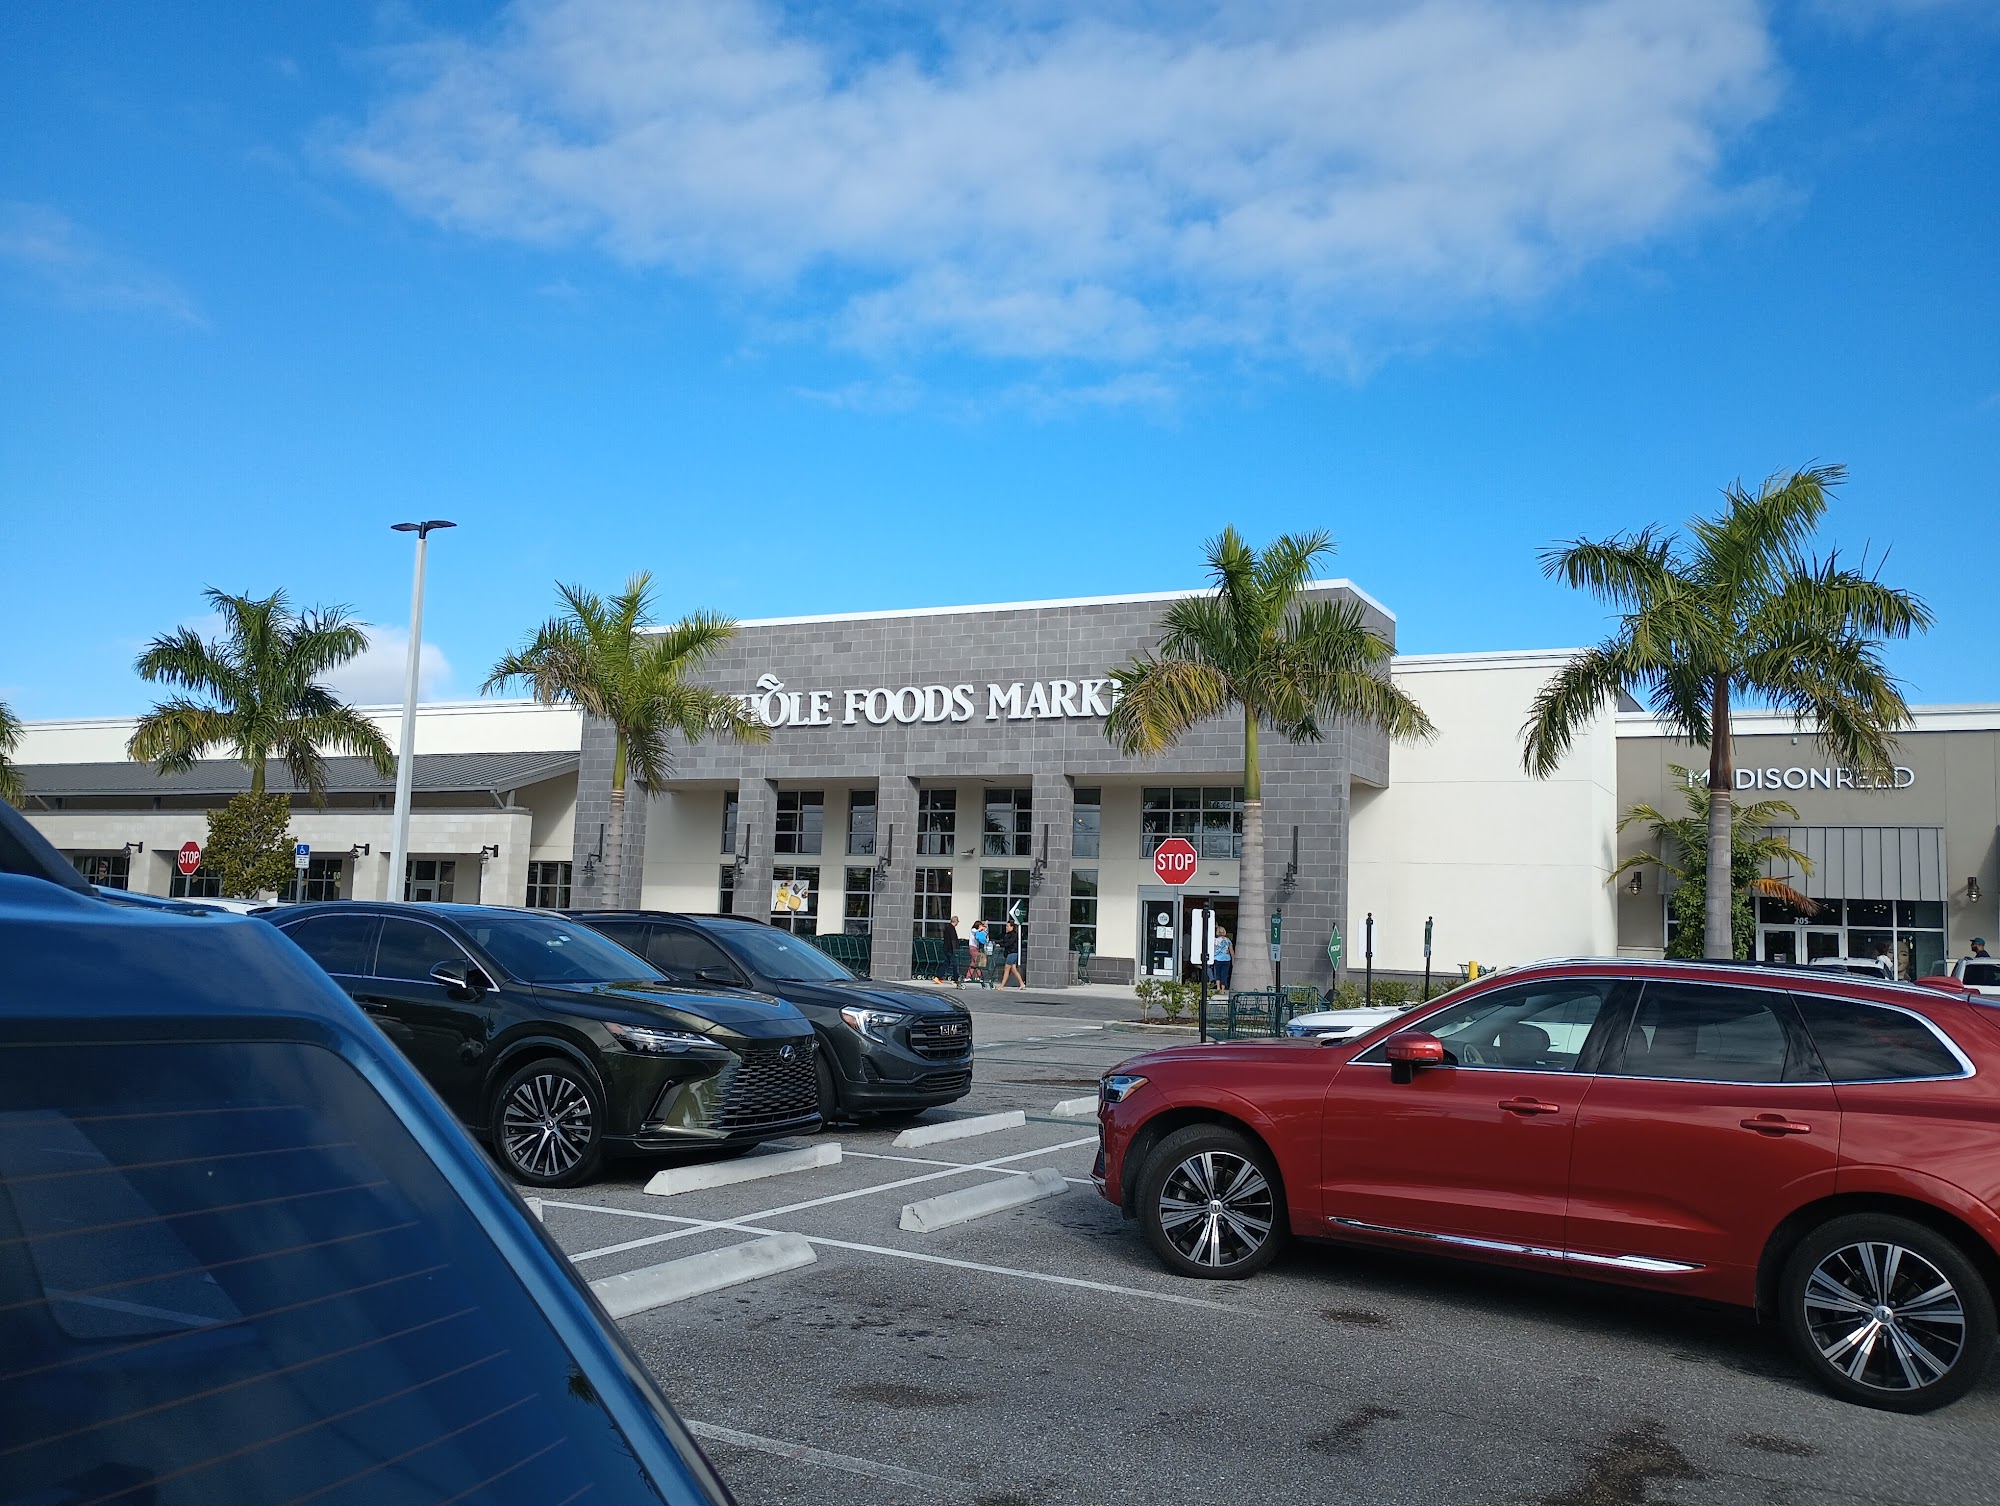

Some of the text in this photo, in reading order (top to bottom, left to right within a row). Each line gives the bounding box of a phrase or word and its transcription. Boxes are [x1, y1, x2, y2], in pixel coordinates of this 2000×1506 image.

[842, 684, 975, 725] FOODS
[985, 678, 1125, 719] MARK
[1687, 767, 1831, 790] MDISON
[180, 851, 200, 864] STOP
[1157, 853, 1195, 871] STOP
[1794, 917, 1809, 925] 205
